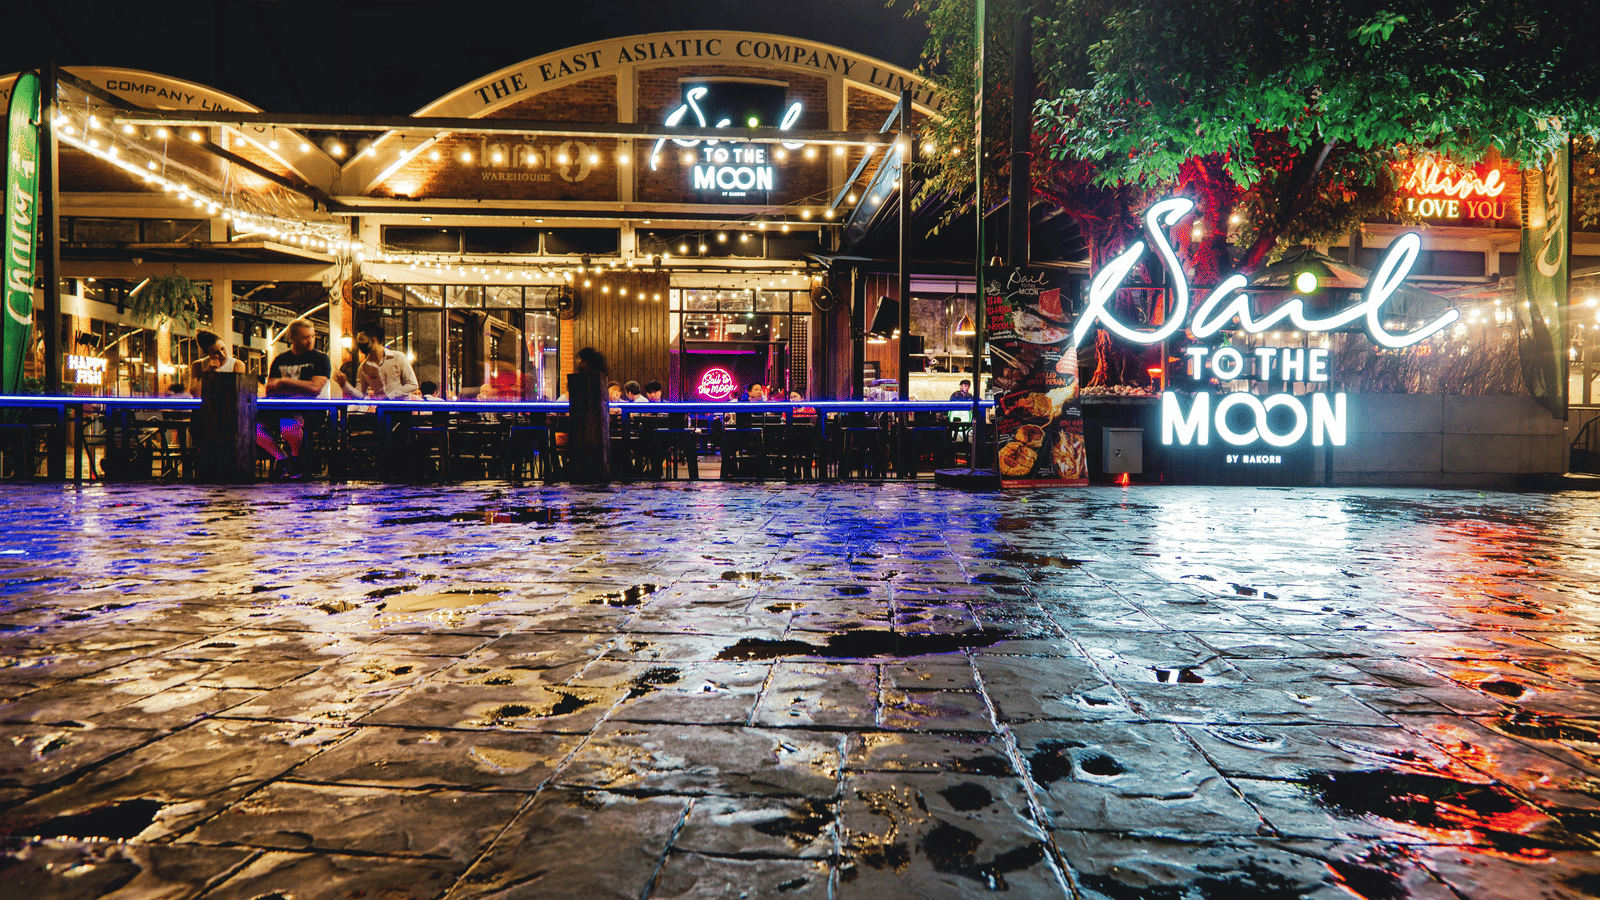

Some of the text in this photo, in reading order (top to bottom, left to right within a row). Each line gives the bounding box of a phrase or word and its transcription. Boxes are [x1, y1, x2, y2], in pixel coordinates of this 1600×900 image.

[474, 38, 947, 112] THE EAST ASIATIC COMPANY LIMIT
[106, 79, 195, 105] COMPANY
[703, 147, 765, 164] TO THE
[481, 172, 551, 182] WAREHOUSE
[694, 165, 773, 191] MOON
[1407, 197, 1460, 218] LOVE
[1466, 200, 1506, 220] YOU
[6, 181, 35, 326] Chang
[1006, 266, 1049, 290] Sail
[1073, 197, 1460, 348] Sail
[1019, 288, 1039, 296] MOON
[986, 305, 1012, 316] SHABU
[988, 321, 1015, 331] NOODLE
[68, 354, 108, 372] HAPPY
[1187, 346, 1330, 382] TO THE
[76, 368, 102, 385] FISH
[704, 371, 730, 386] Sail to
[698, 384, 711, 394] the
[1160, 391, 1348, 448] MOON
[1226, 454, 1282, 464] BY NAKORN
